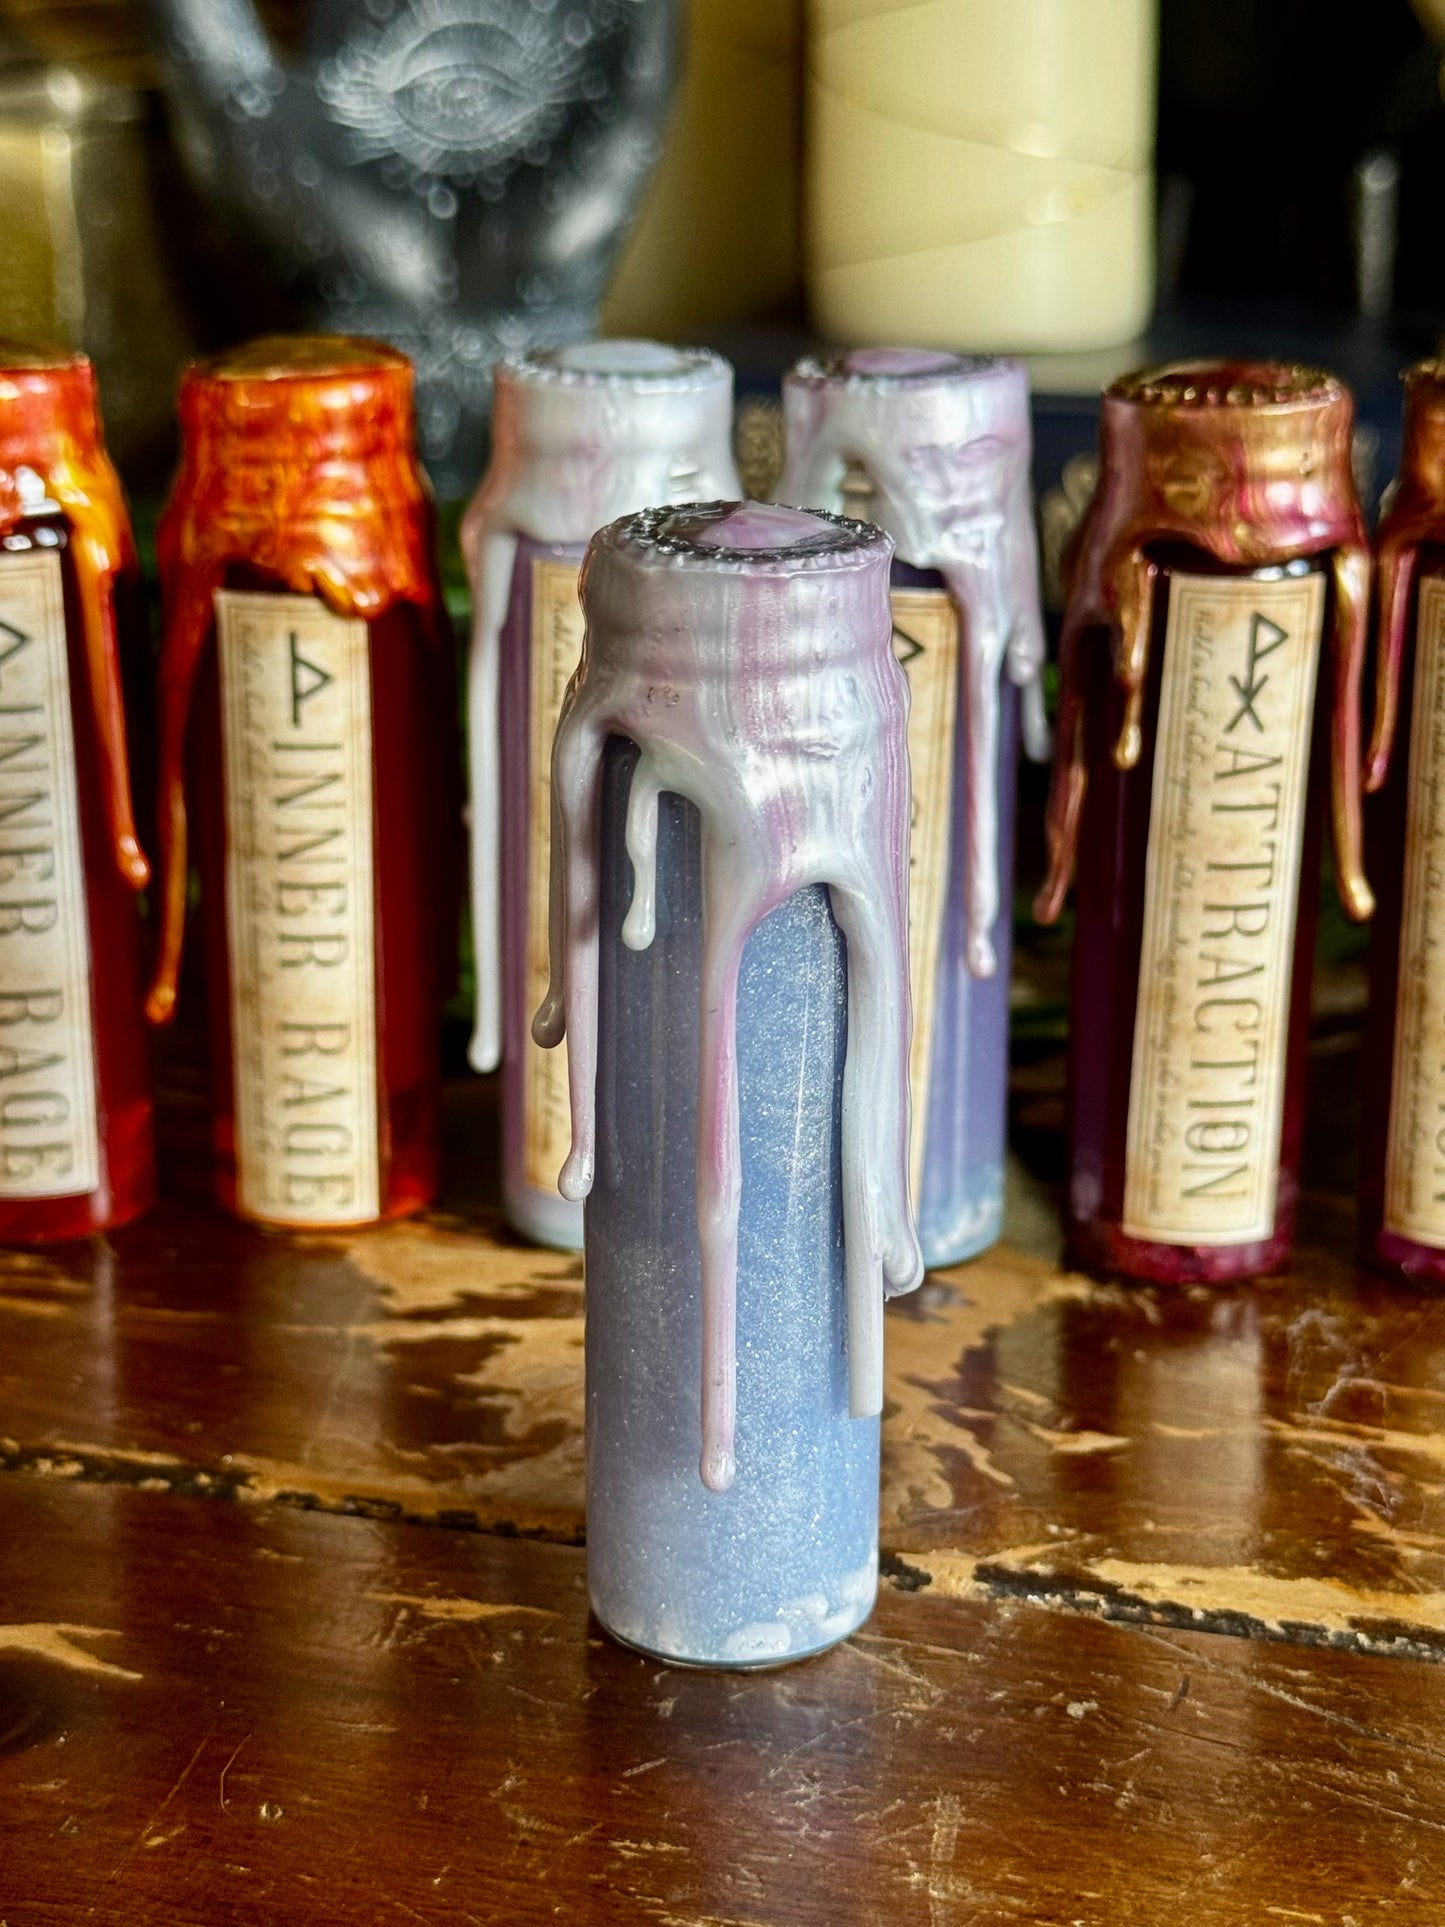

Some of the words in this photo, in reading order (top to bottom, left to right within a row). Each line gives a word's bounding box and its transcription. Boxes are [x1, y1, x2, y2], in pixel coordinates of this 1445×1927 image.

[0, 703, 57, 936] INNER
[272, 740, 346, 968] INNER
[0, 987, 71, 1180] RAGE
[1181, 744, 1283, 1199] ATTRACTION
[278, 1022, 354, 1206] RAGE
